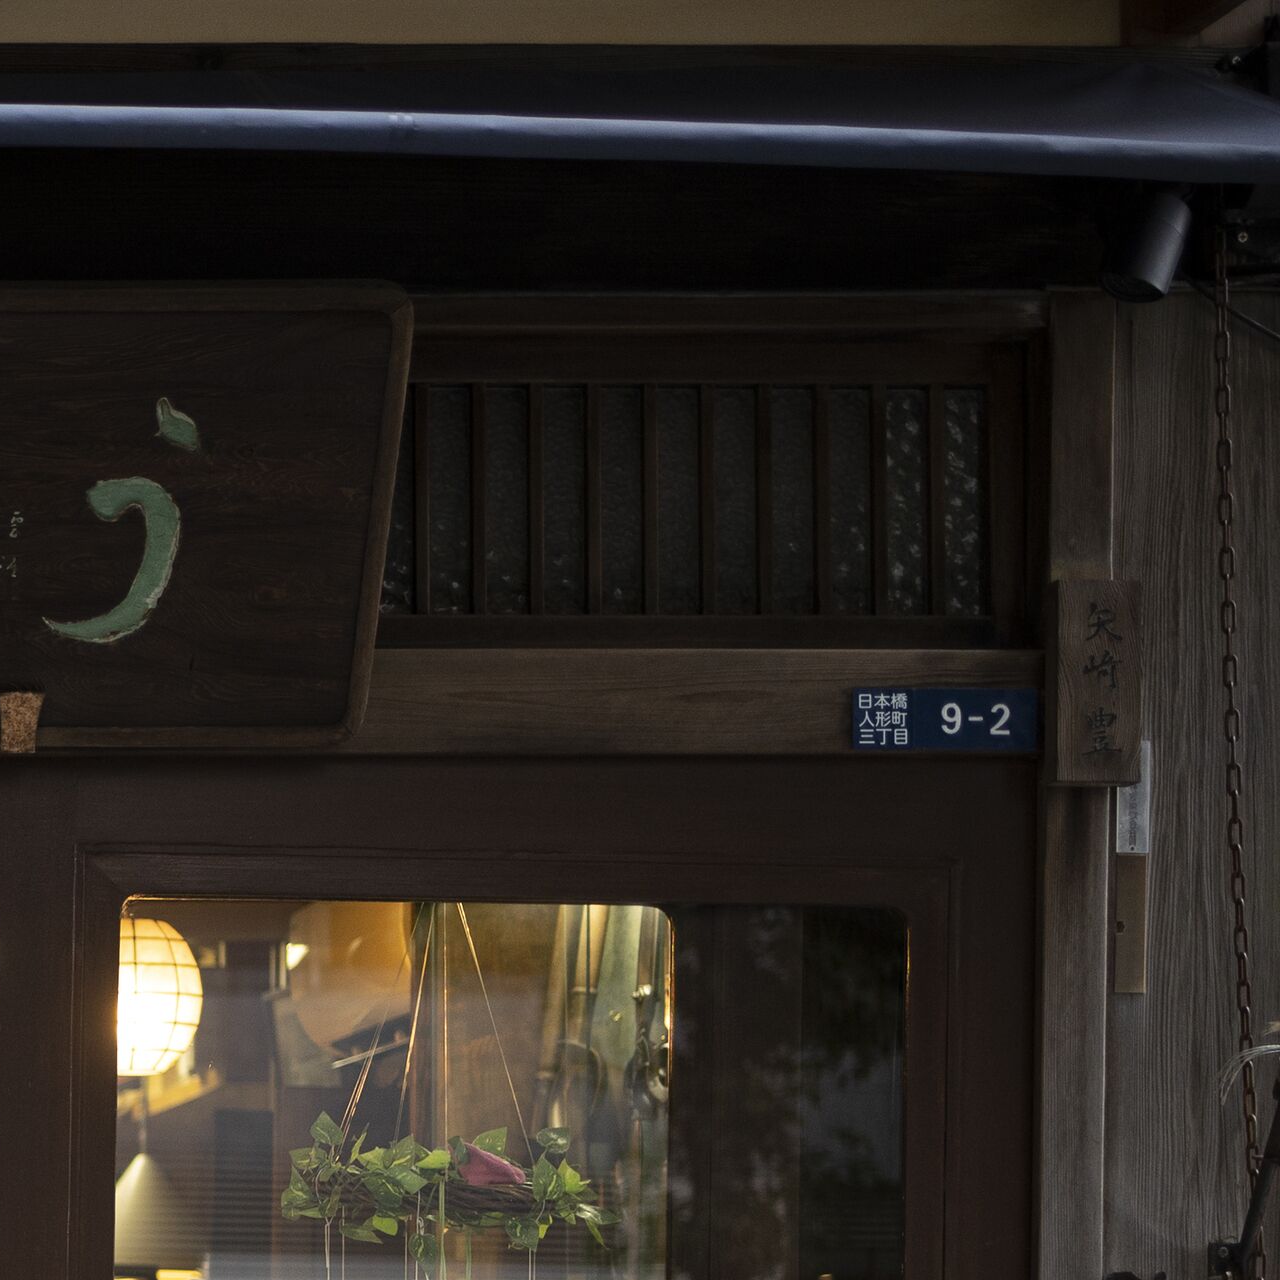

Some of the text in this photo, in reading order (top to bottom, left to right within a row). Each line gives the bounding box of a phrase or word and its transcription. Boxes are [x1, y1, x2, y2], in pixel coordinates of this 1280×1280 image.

[858, 692, 908, 710] 日本橋
[858, 711, 908, 728] 人形町
[941, 702, 1010, 735] 9-2
[858, 728, 908, 746] 三丁目
